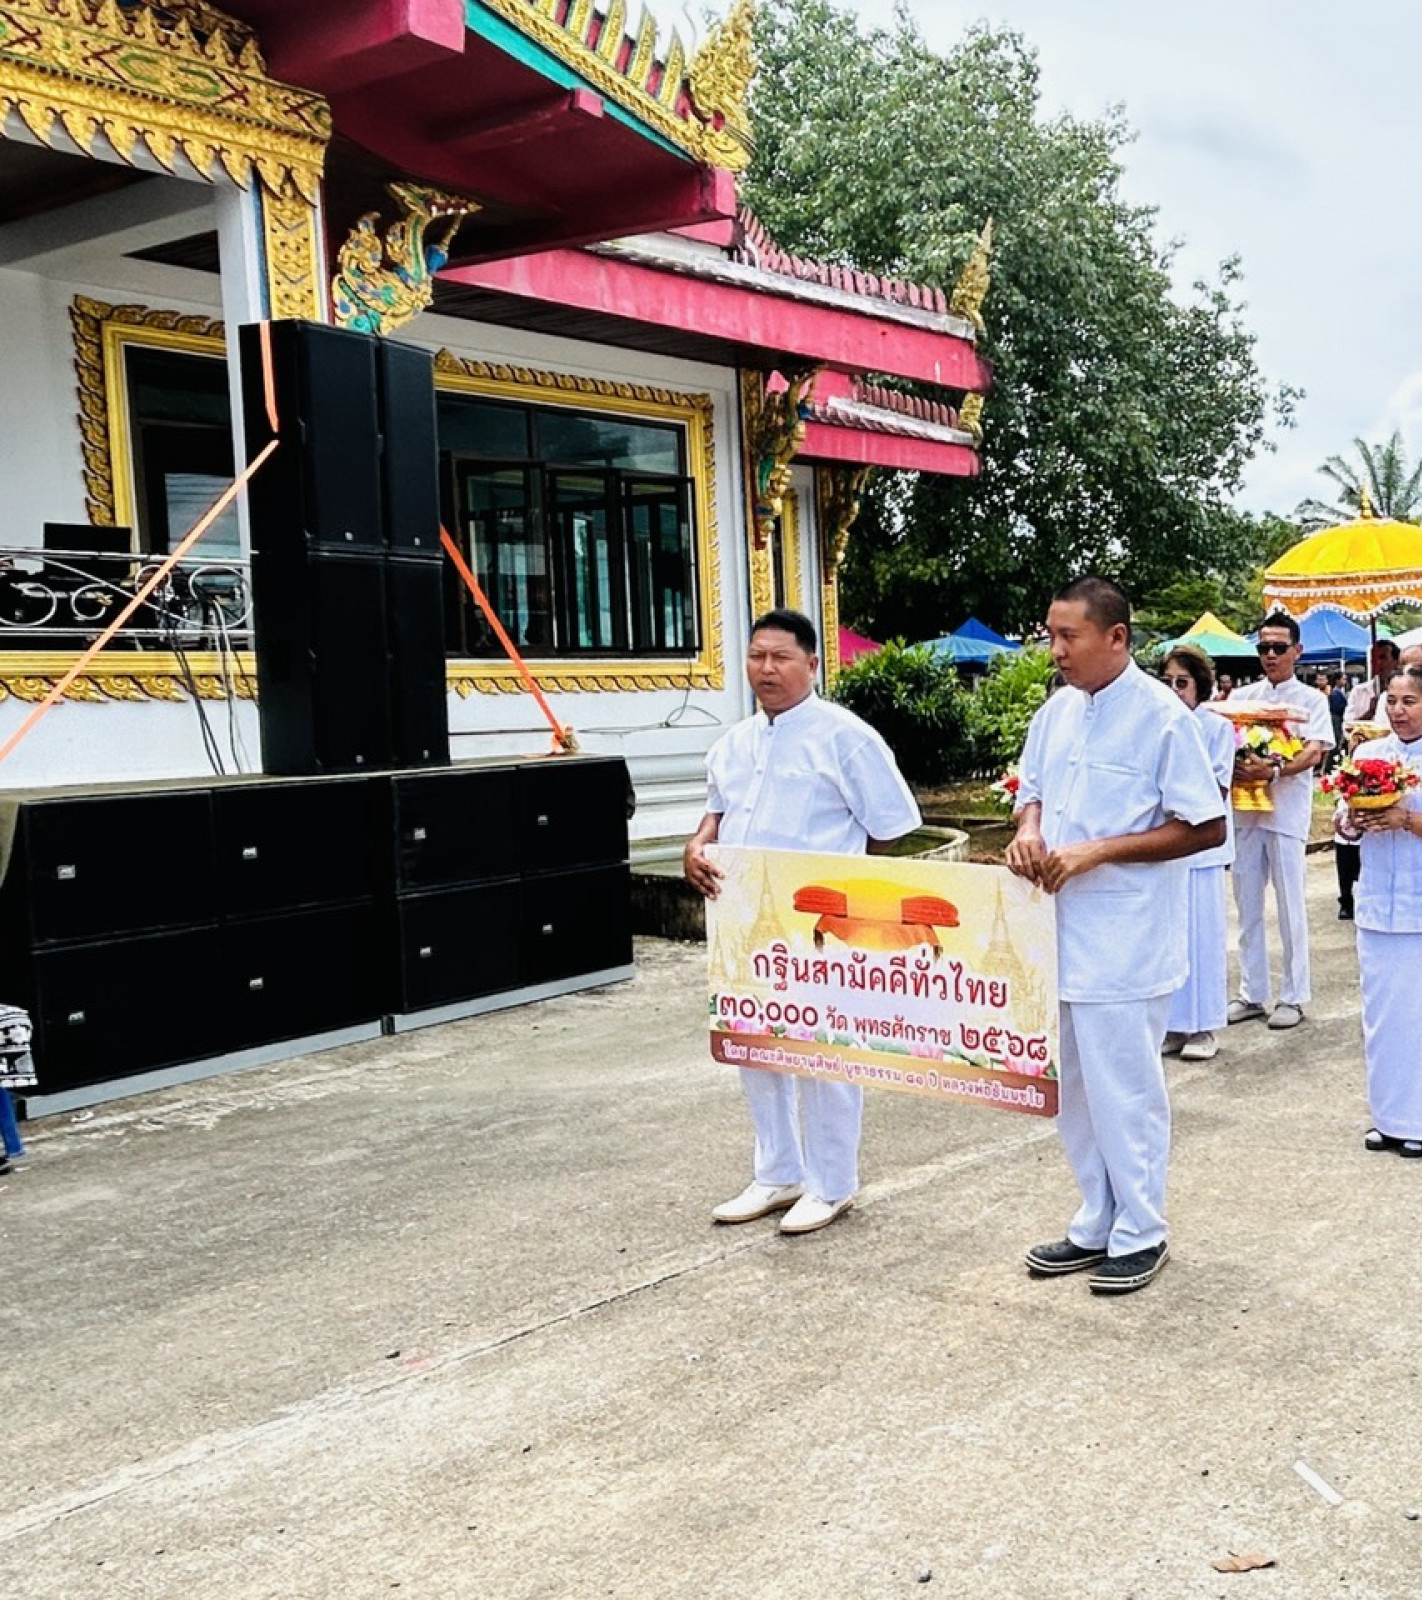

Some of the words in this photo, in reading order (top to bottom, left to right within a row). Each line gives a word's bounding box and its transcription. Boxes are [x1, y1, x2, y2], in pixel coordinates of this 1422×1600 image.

[754, 943, 1008, 1007] กฐินสามัคคีทั่วไทย
[719, 995, 819, 1027] ๓๐,๐๐๐
[826, 1004, 848, 1031] วัด
[853, 1014, 952, 1043] พุทธศักราช
[959, 1022, 1048, 1061] ๒๕๖๘
[723, 1040, 747, 1059] โดย
